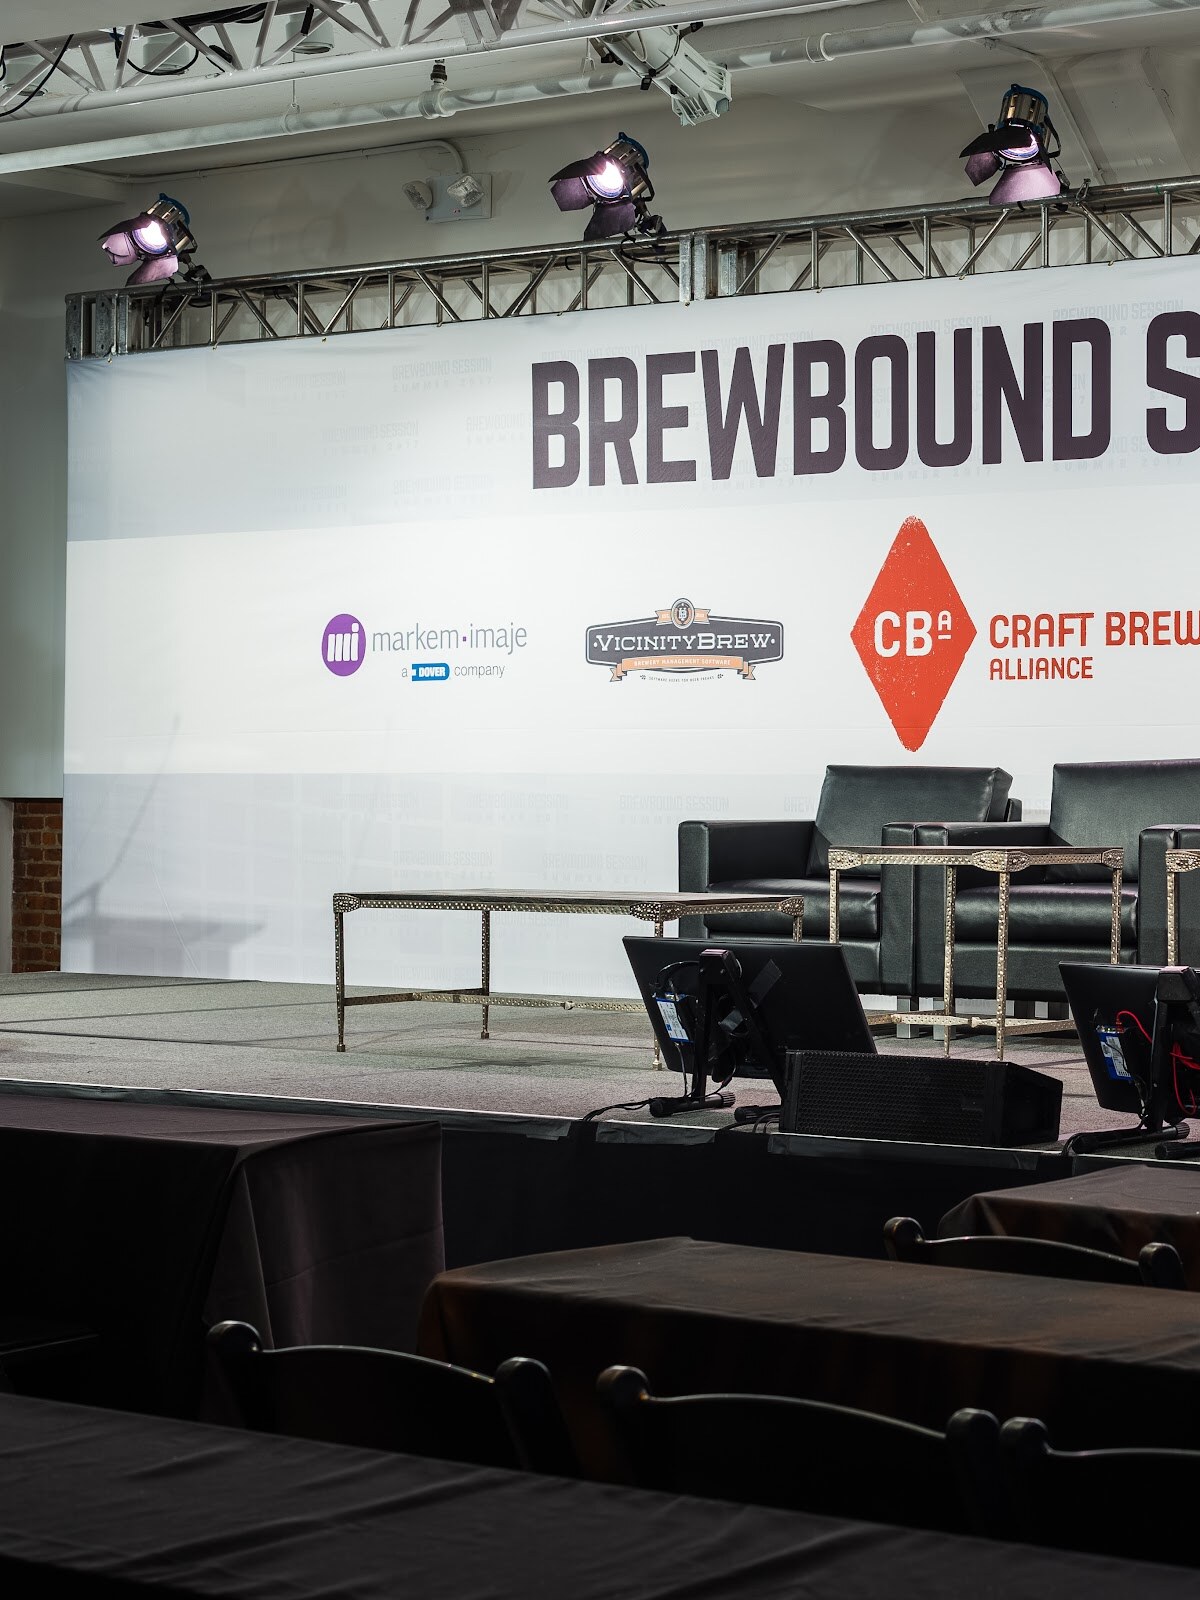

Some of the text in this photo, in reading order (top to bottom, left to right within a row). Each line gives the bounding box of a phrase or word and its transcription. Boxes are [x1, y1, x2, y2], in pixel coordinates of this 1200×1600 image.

[532, 317, 1111, 489] BREWBOUND
[873, 611, 952, 658] CBA
[989, 612, 1095, 649] CRAFT
[401, 665, 505, 679] a DOVER company
[701, 658, 731, 666] SOFTWARE
[989, 656, 1093, 681] ALLIANCE
